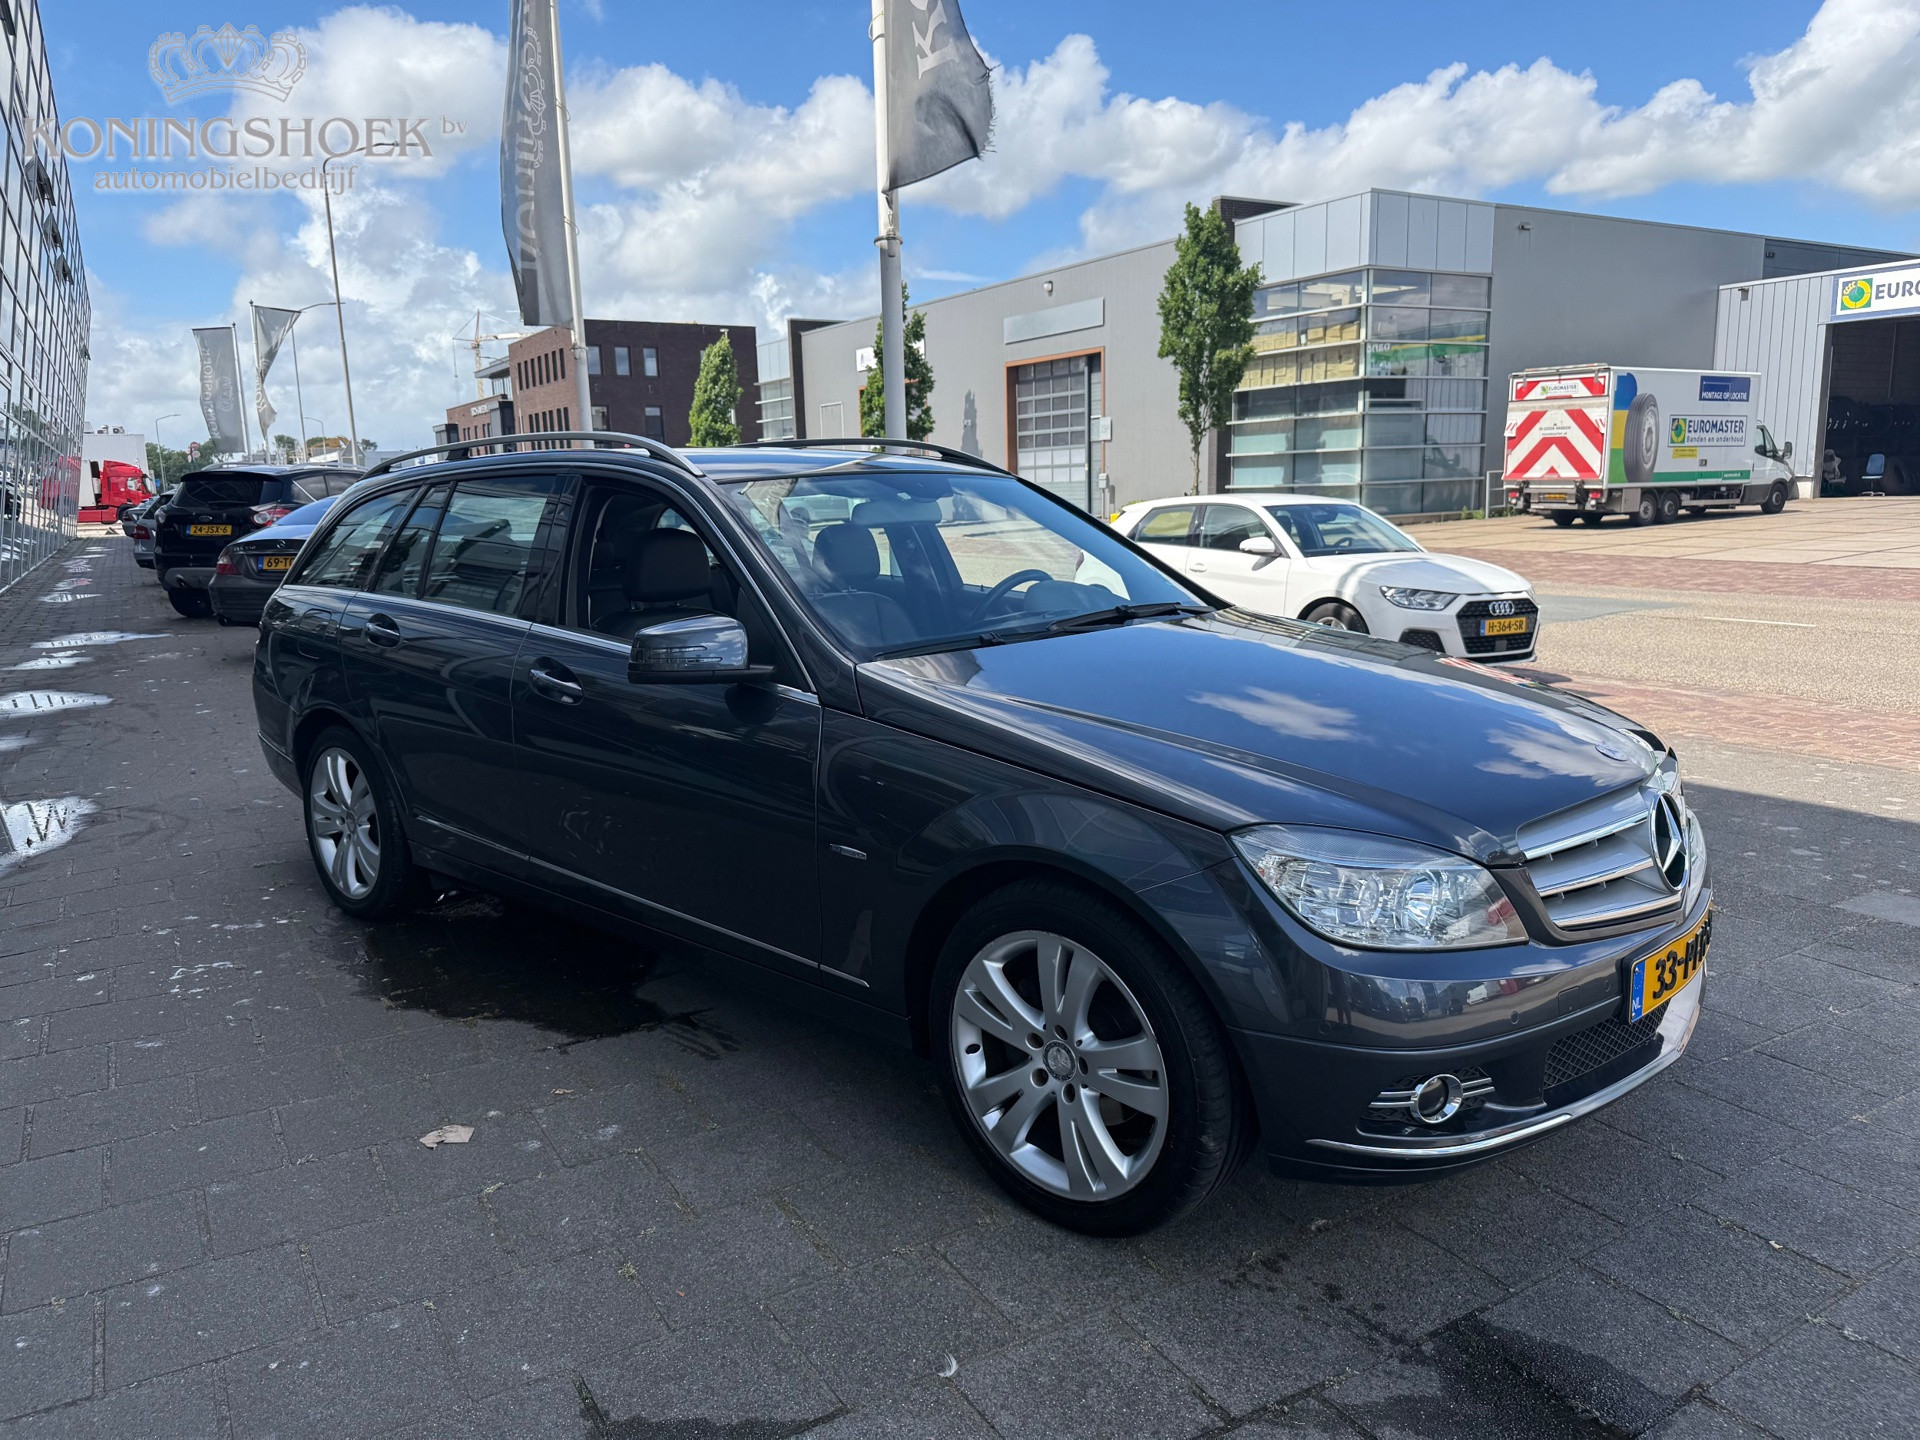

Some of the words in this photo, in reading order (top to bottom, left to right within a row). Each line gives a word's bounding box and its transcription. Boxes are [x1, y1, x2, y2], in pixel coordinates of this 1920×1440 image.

[1701, 391, 1723, 399] MONTAGE
[1730, 392, 1748, 400] LOCATIE
[1687, 420, 1744, 433] EUROMASTER
[193, 525, 228, 534] 24-JSX-6
[1488, 620, 1524, 633] H-364-SR
